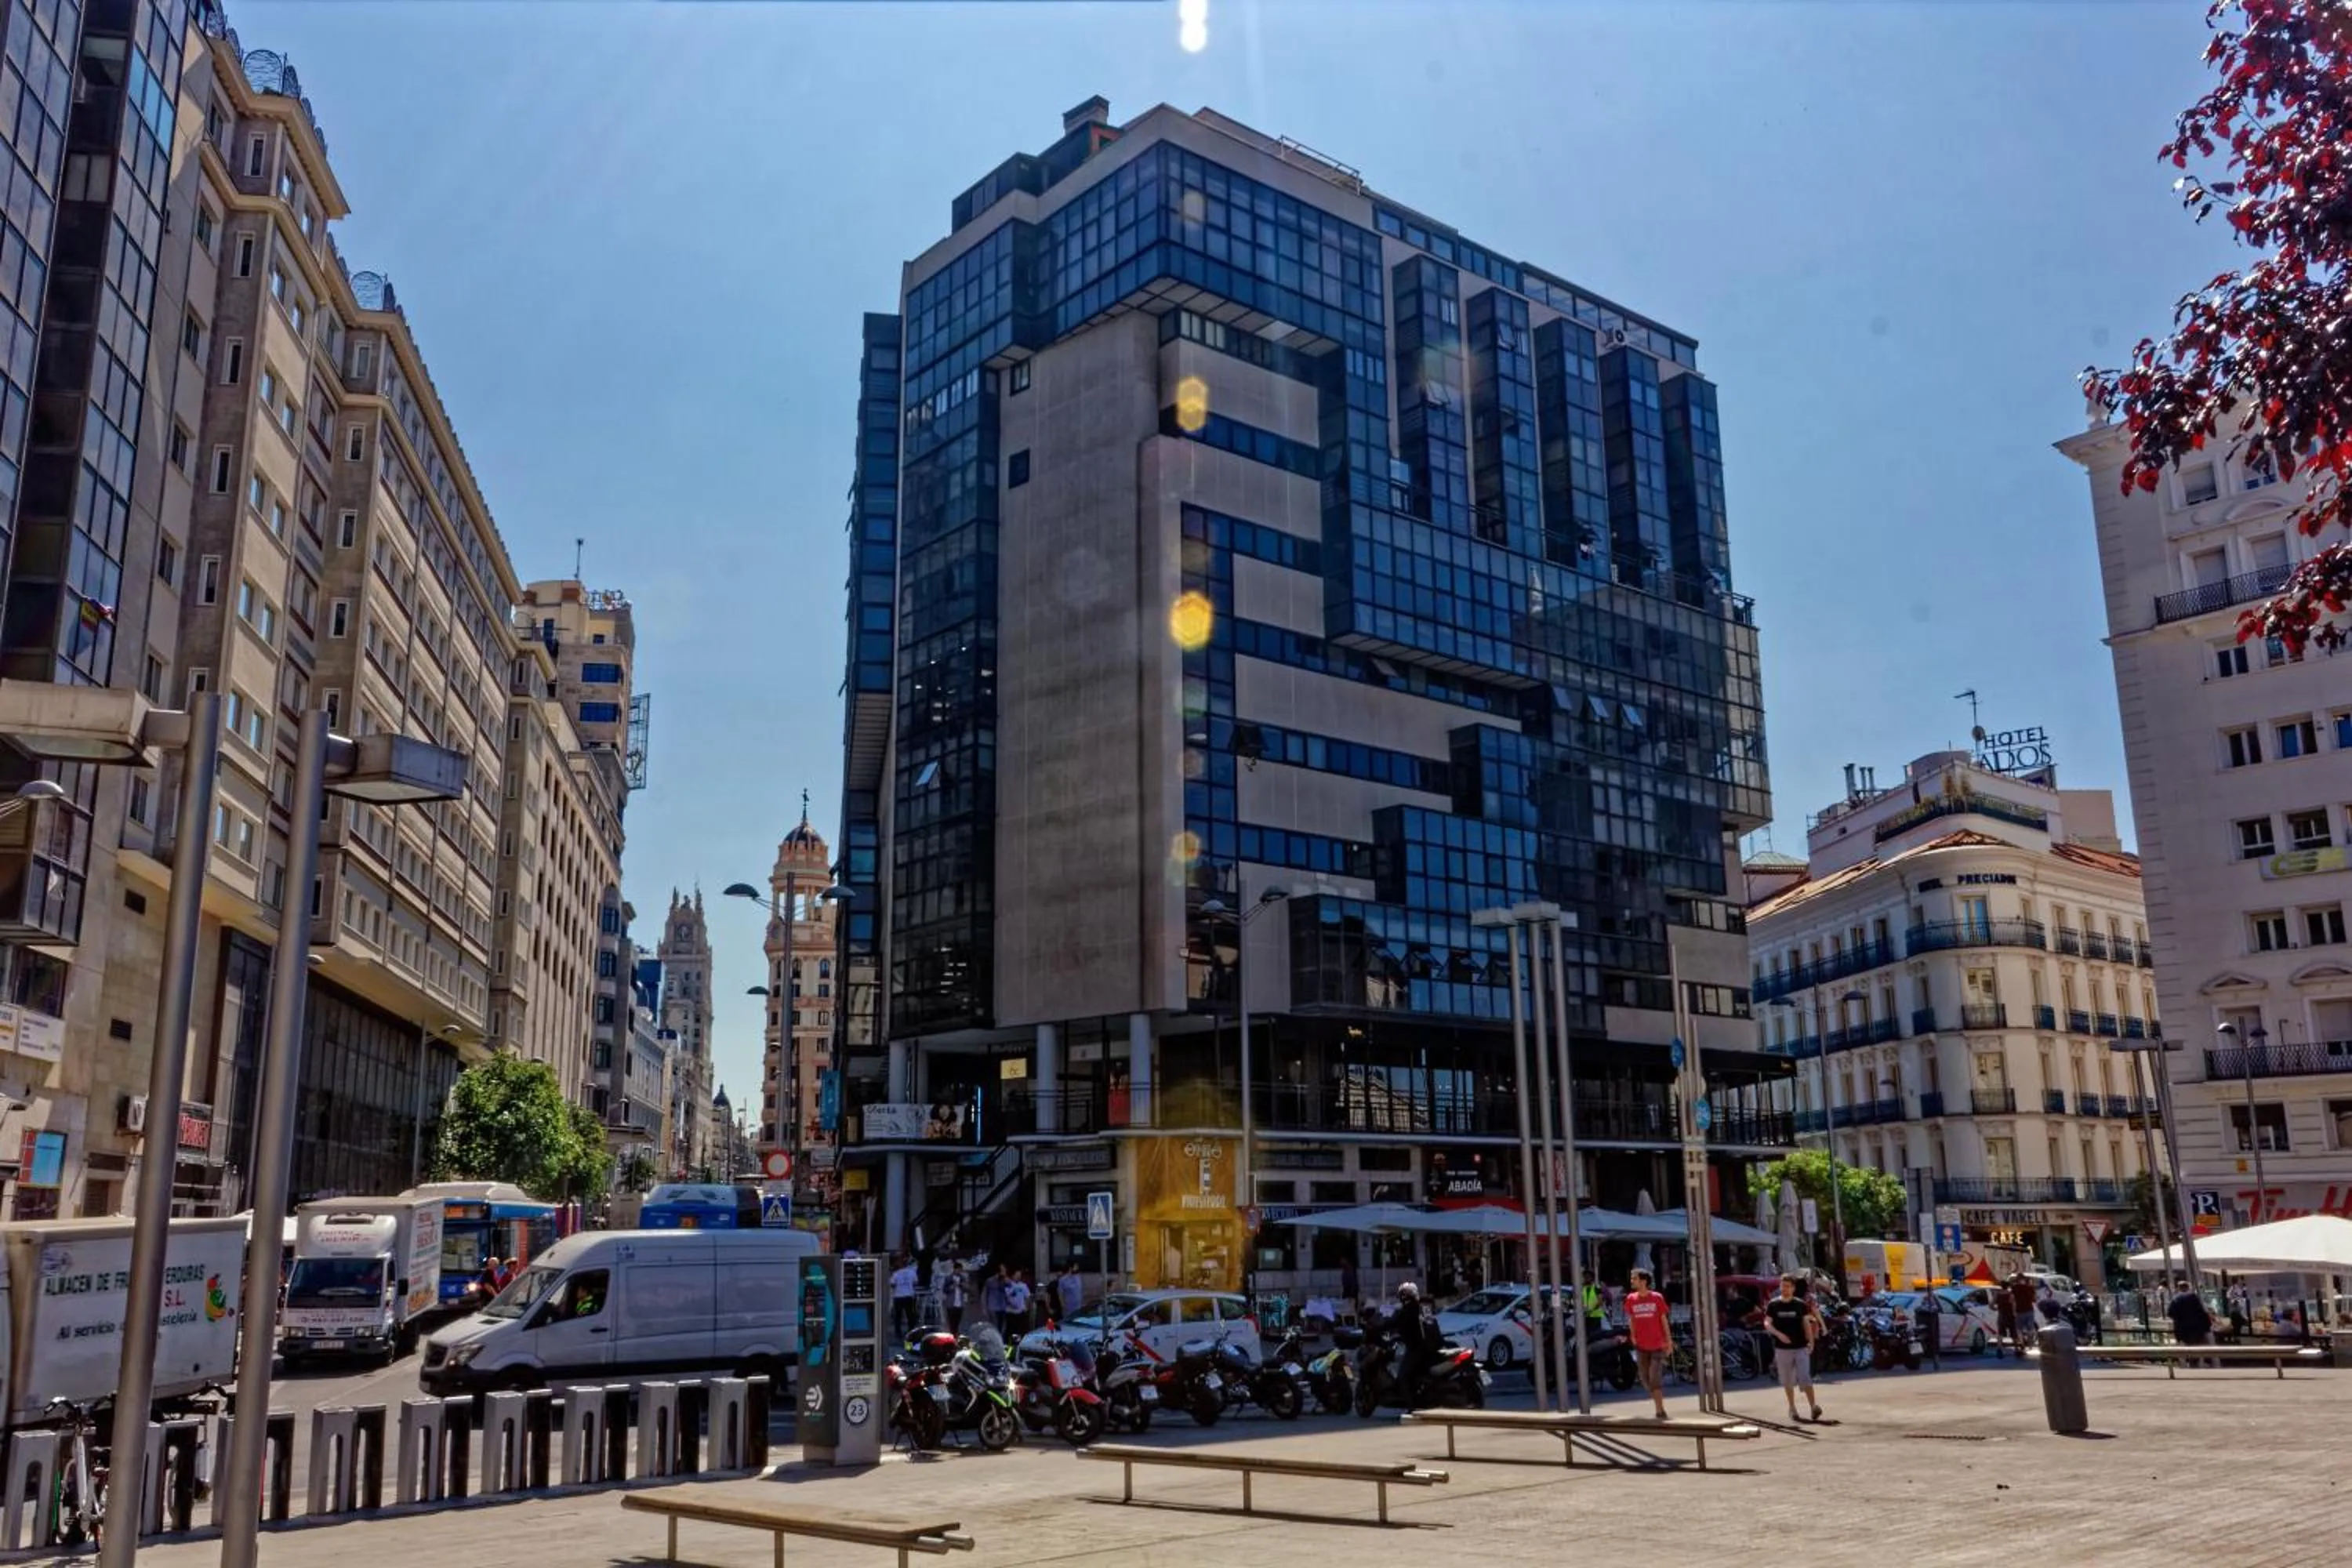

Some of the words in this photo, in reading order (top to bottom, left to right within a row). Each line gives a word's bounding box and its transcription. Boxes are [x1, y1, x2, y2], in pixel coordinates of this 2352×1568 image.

[1984, 727, 2048, 749] HOTEL
[1448, 1178, 1483, 1192] ABADÍA
[45, 1274, 92, 1296] ALMACEN
[96, 1272, 111, 1292] DE
[165, 1263, 205, 1284] ERDURAS
[850, 1404, 864, 1416] 23
